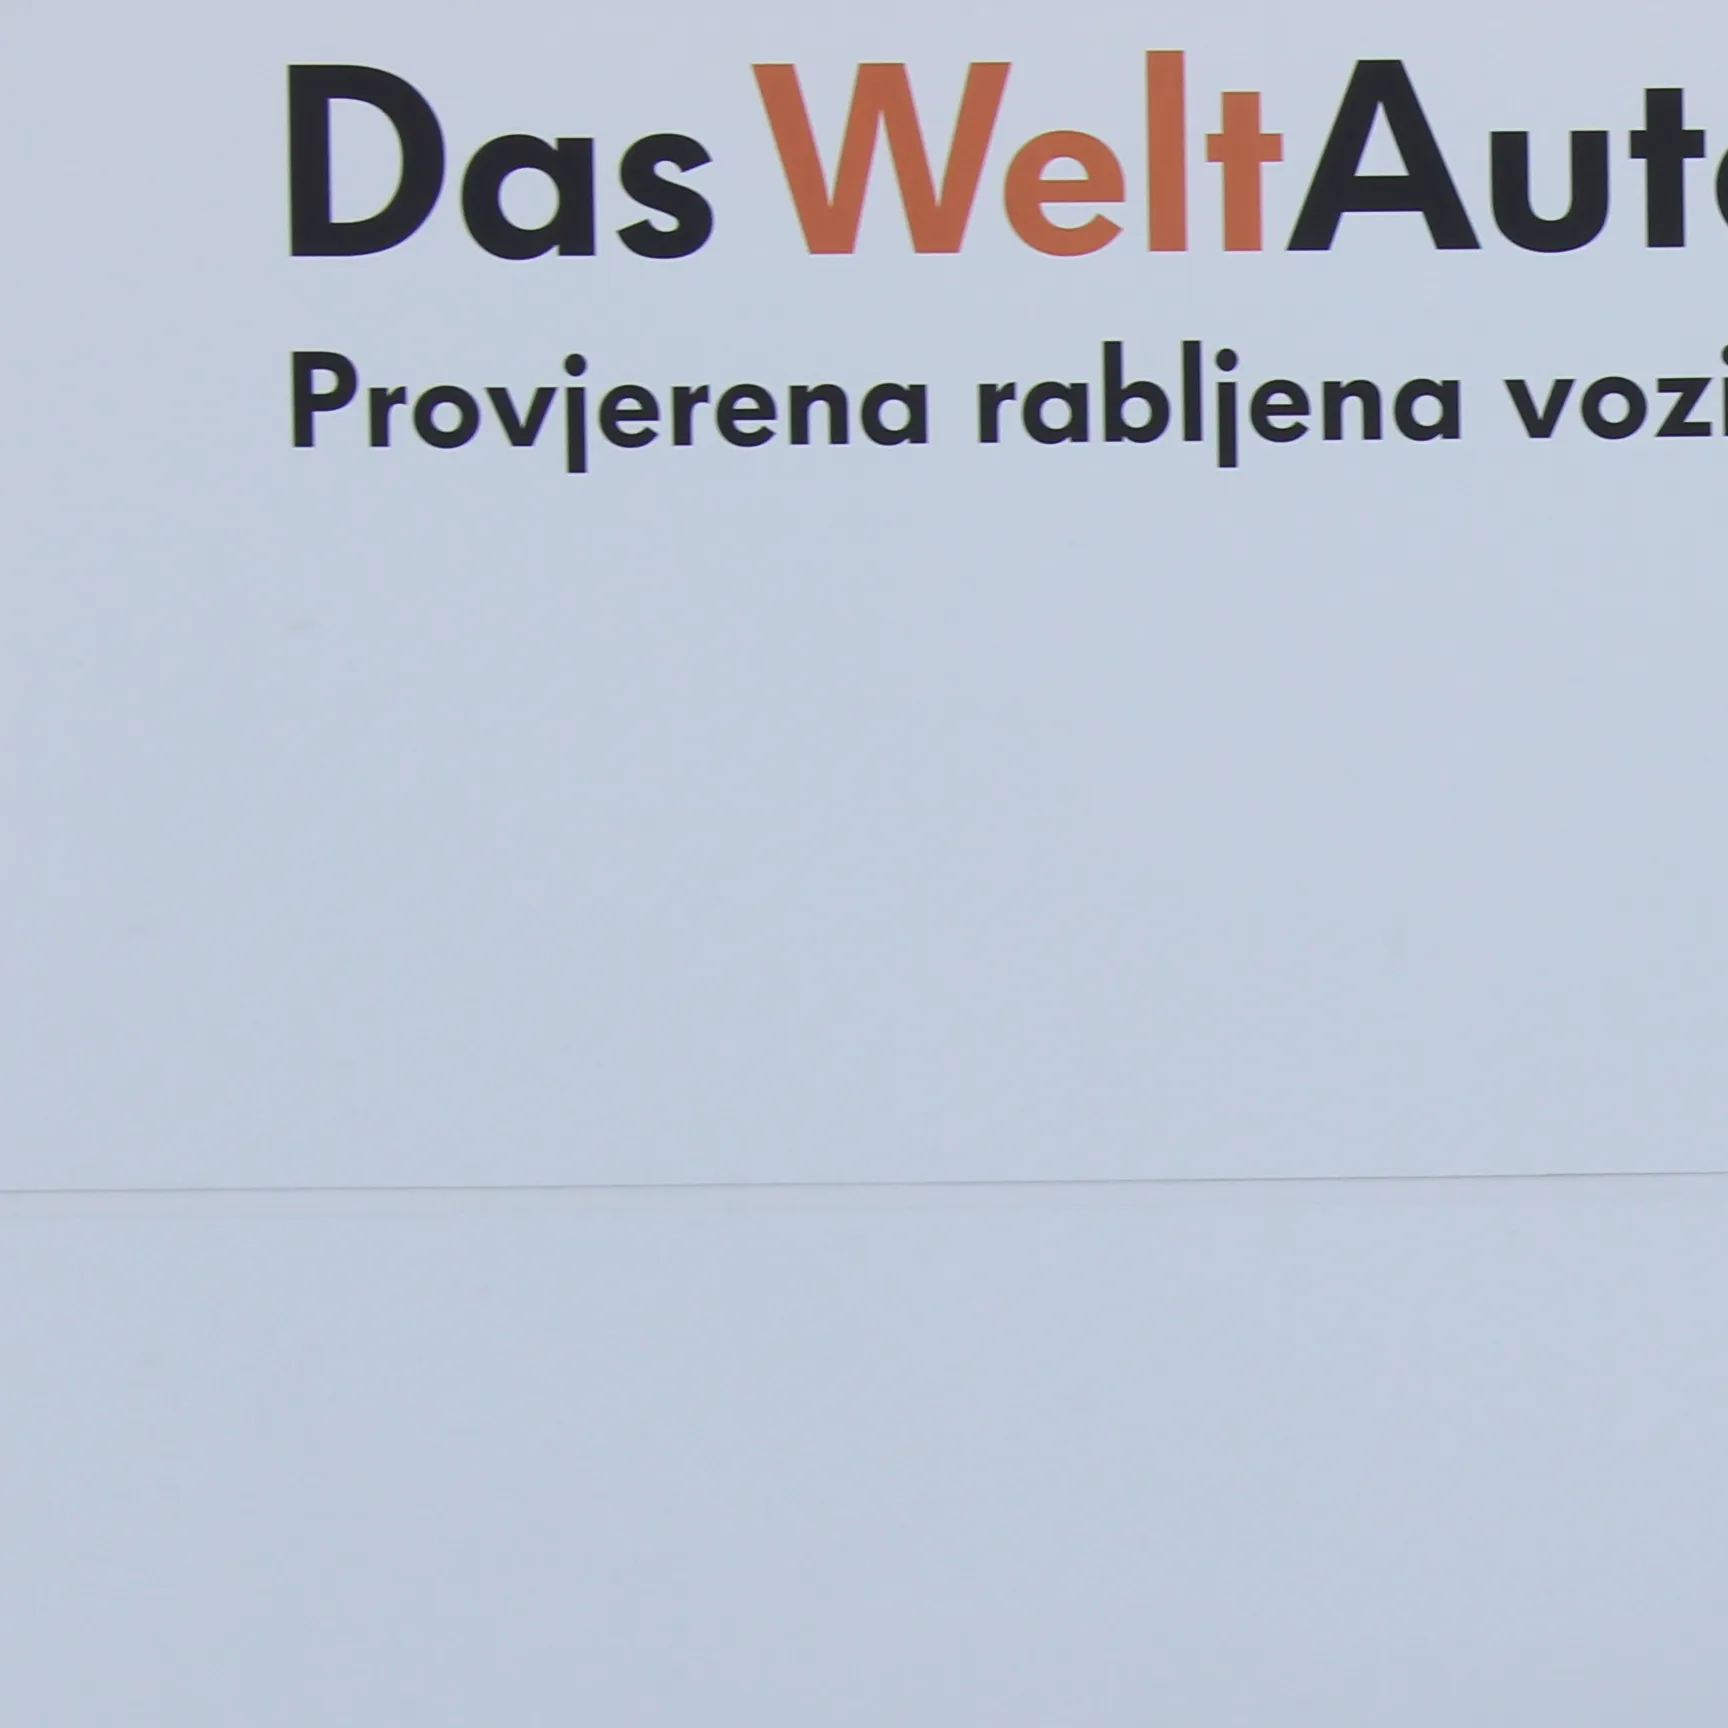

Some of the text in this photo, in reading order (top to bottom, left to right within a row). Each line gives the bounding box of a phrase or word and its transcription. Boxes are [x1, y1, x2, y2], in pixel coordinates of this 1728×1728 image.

[287, 64, 714, 261] Das
[291, 350, 928, 474] Provjerena
[978, 339, 1461, 469] rabljena
